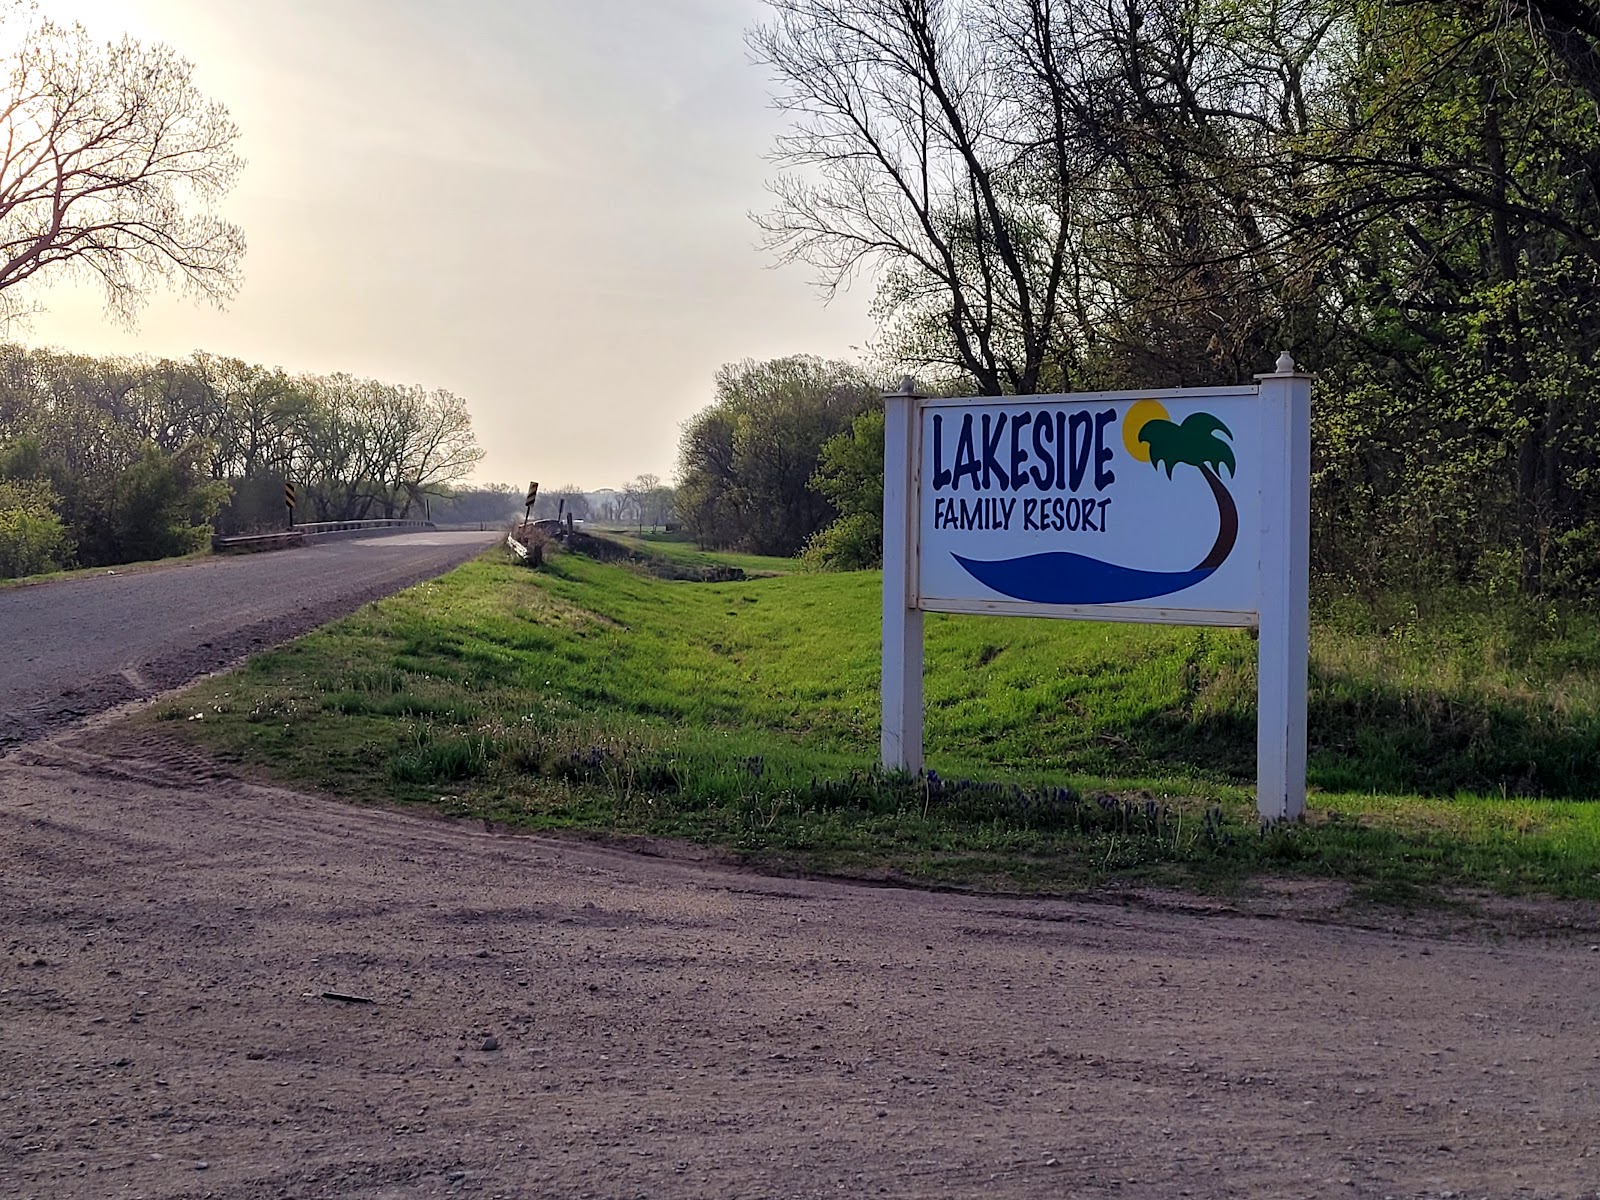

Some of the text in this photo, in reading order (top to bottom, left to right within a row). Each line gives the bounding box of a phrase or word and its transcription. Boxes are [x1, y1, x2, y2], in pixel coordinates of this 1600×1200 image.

[932, 407, 1118, 493] LAKESIDE
[934, 497, 1112, 533] FAMILY RESORT
